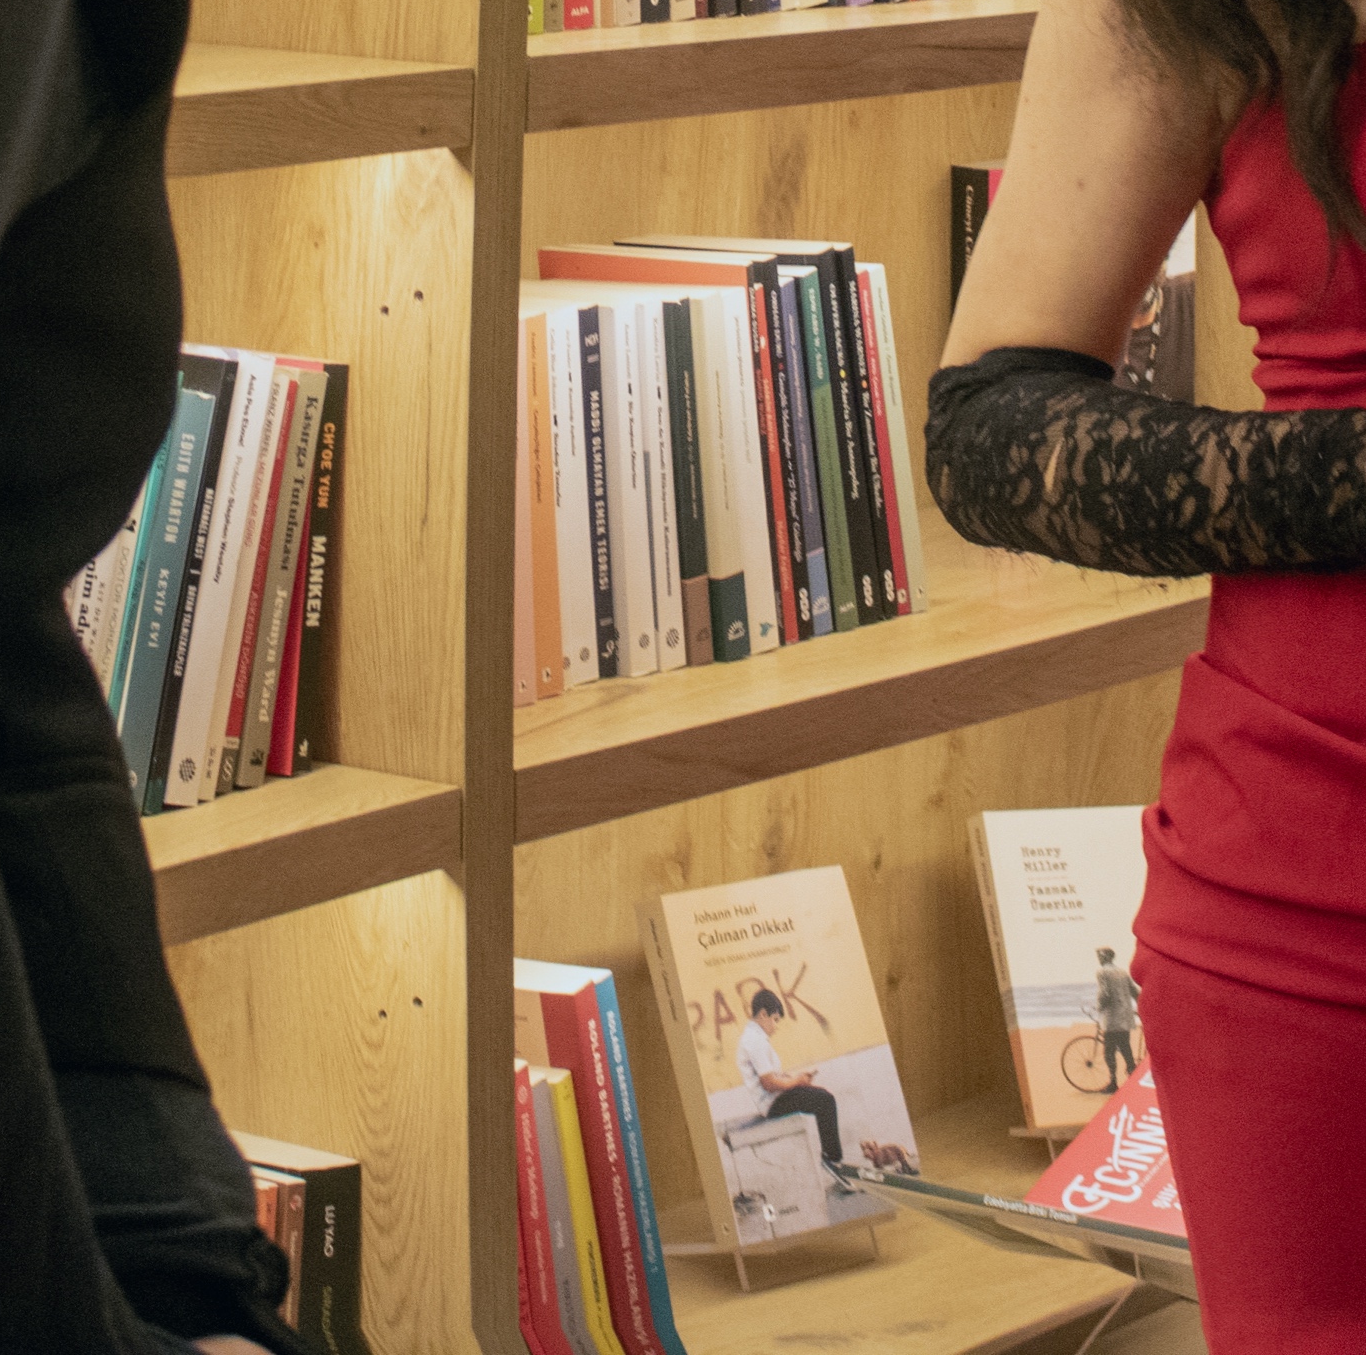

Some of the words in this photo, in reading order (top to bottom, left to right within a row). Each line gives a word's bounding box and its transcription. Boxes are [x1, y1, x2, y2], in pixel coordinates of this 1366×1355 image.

[178, 432, 195, 474] EDITH
[293, 394, 320, 472] Kasırga
[319, 422, 337, 471] CH'OE
[164, 479, 187, 544] WHARTON
[316, 473, 332, 510] YUN
[280, 476, 306, 572] Tutulması
[594, 500, 606, 536] EMEK
[153, 567, 170, 617] KEYİF
[305, 534, 328, 628] MANKEN
[147, 619, 161, 649] EVİ
[265, 585, 289, 663] Jesmyn
[257, 665, 276, 724] Ward
[1020, 846, 1061, 859] Henry
[1023, 861, 1068, 873] Miller
[693, 908, 731, 926] Johann
[734, 902, 757, 918] Hari
[697, 928, 750, 951] Çalınan
[751, 917, 796, 938] Dikkat
[587, 1018, 606, 1087] ROLAND
[598, 1088, 618, 1163] BARTHES
